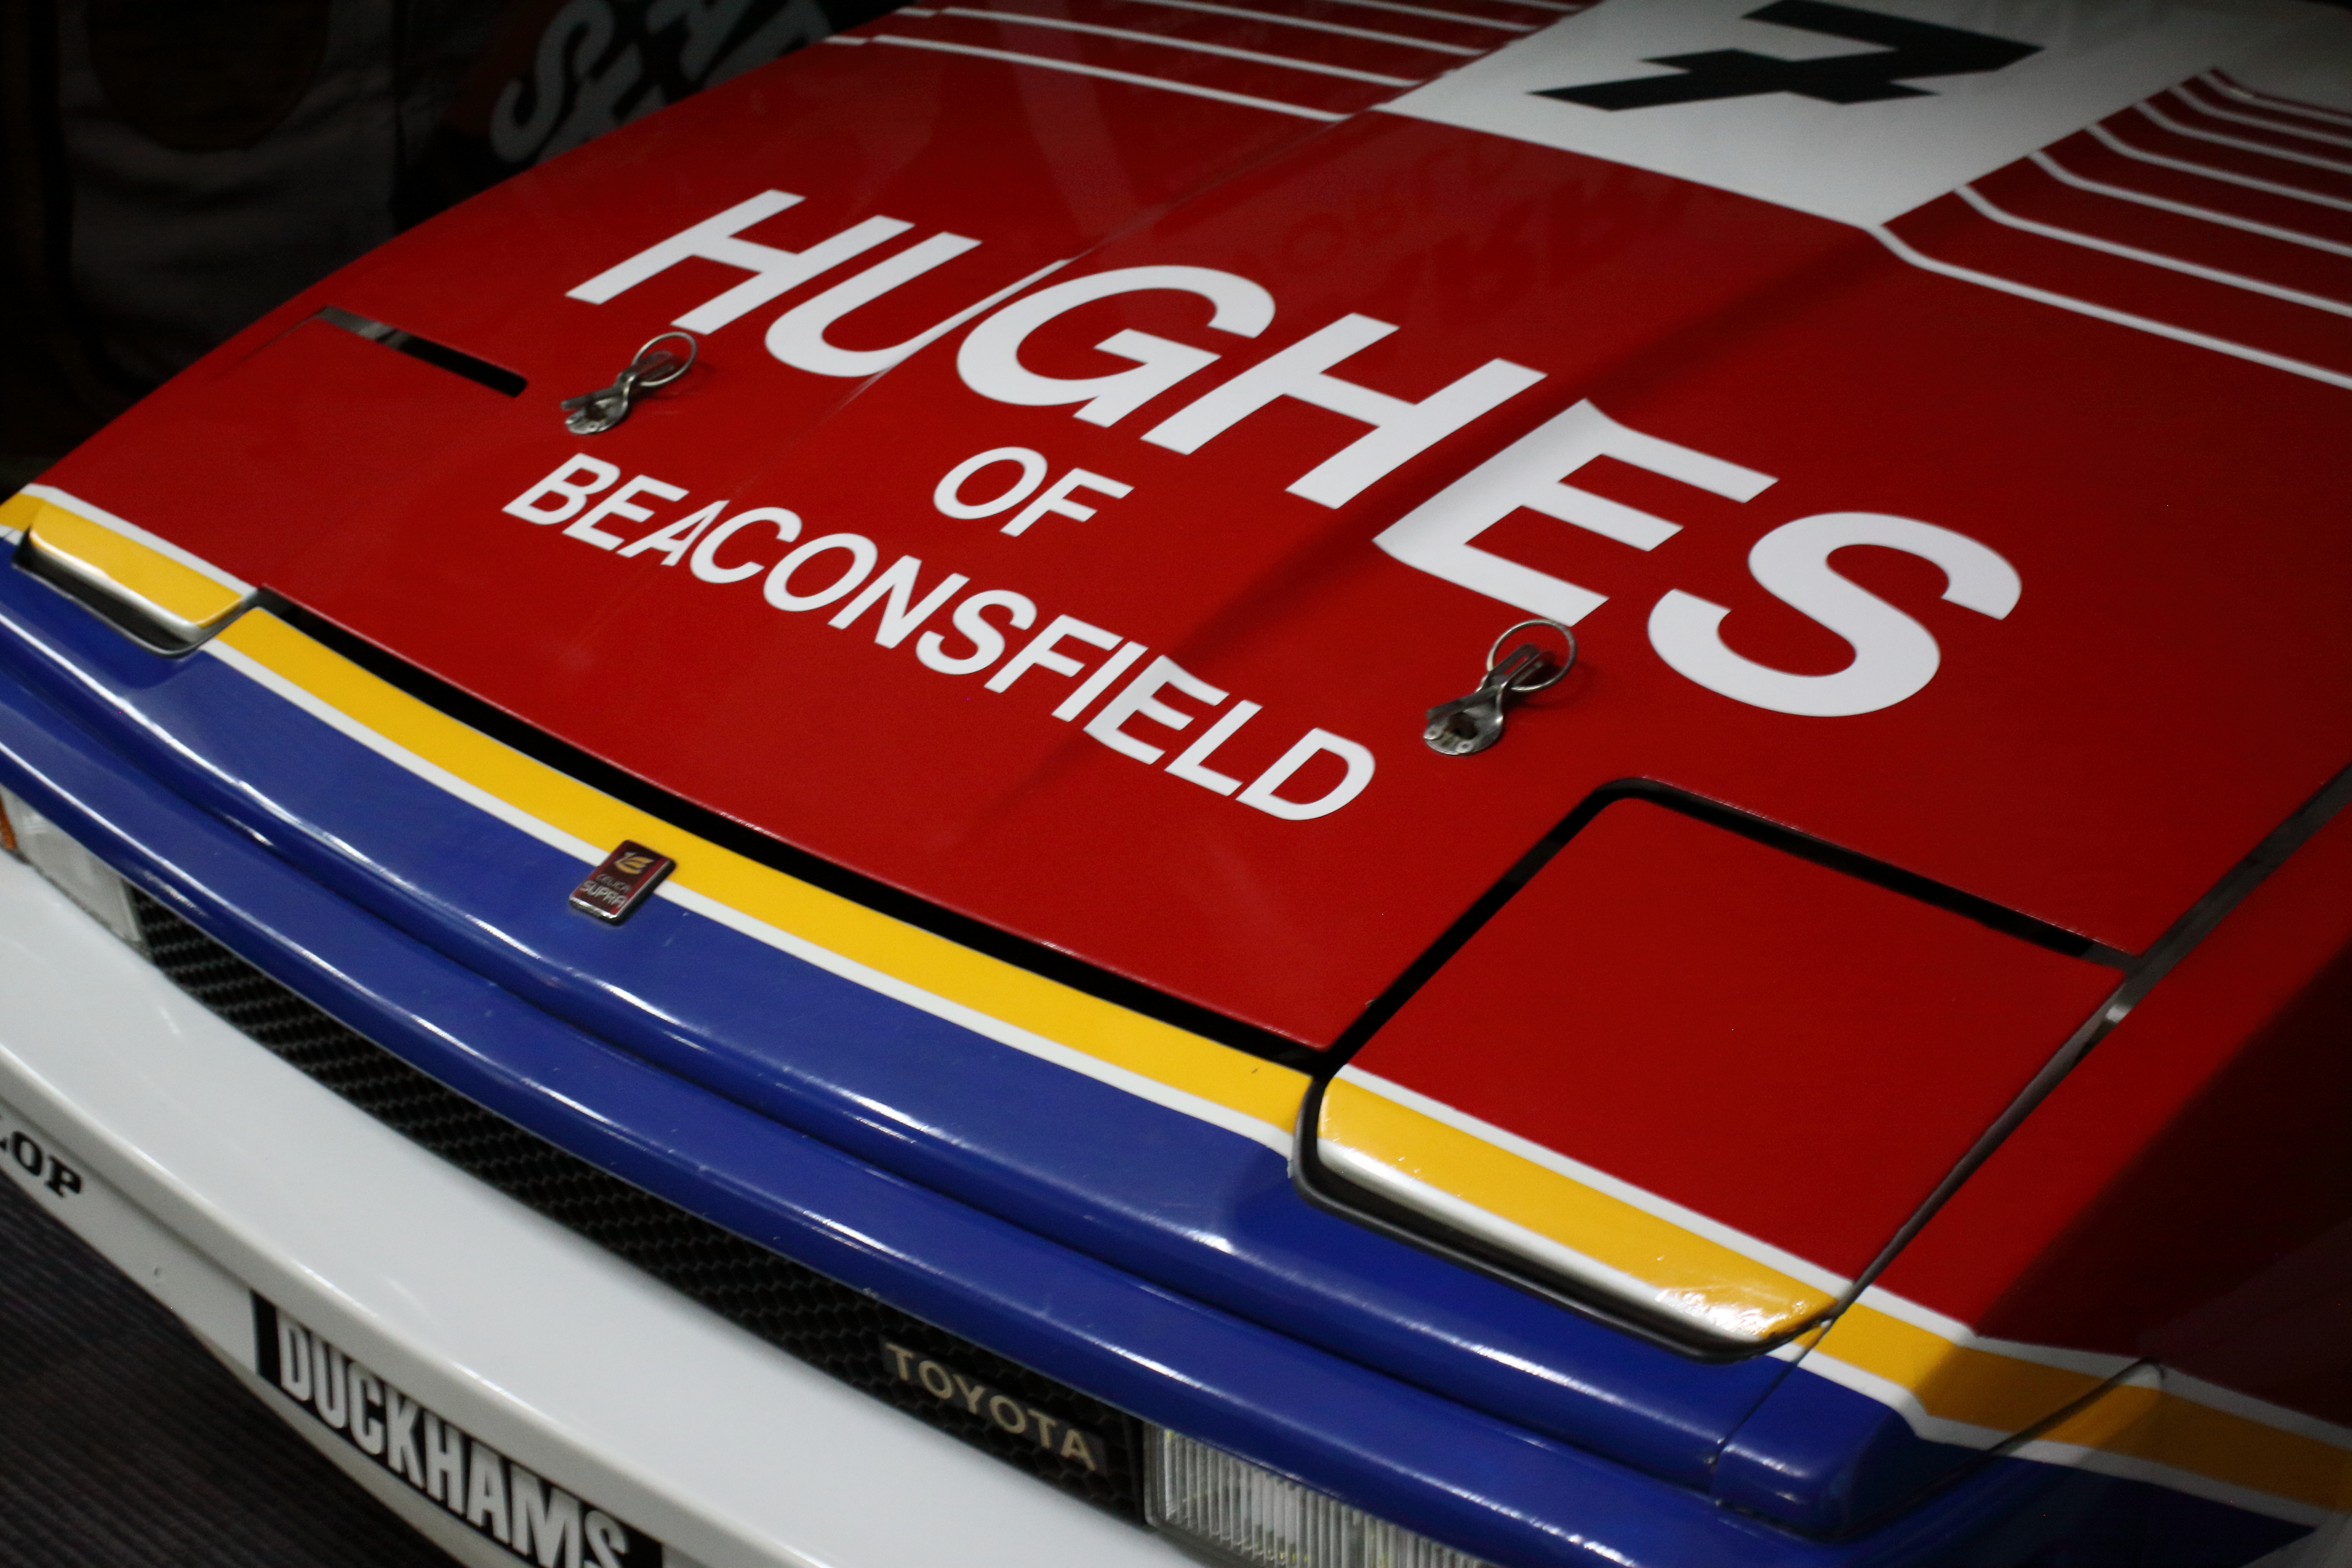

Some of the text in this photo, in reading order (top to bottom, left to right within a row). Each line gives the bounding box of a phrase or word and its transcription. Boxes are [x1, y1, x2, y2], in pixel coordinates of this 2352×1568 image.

[564, 189, 2022, 718] HUGHES
[933, 446, 1134, 537] OF
[501, 452, 1376, 822] BEACONSFIELD
[579, 880, 628, 909] SUPRA
[0, 1130, 82, 1199] OP
[277, 1311, 628, 1568] DUCKHAMS
[885, 1341, 1097, 1471] TOYOTA
